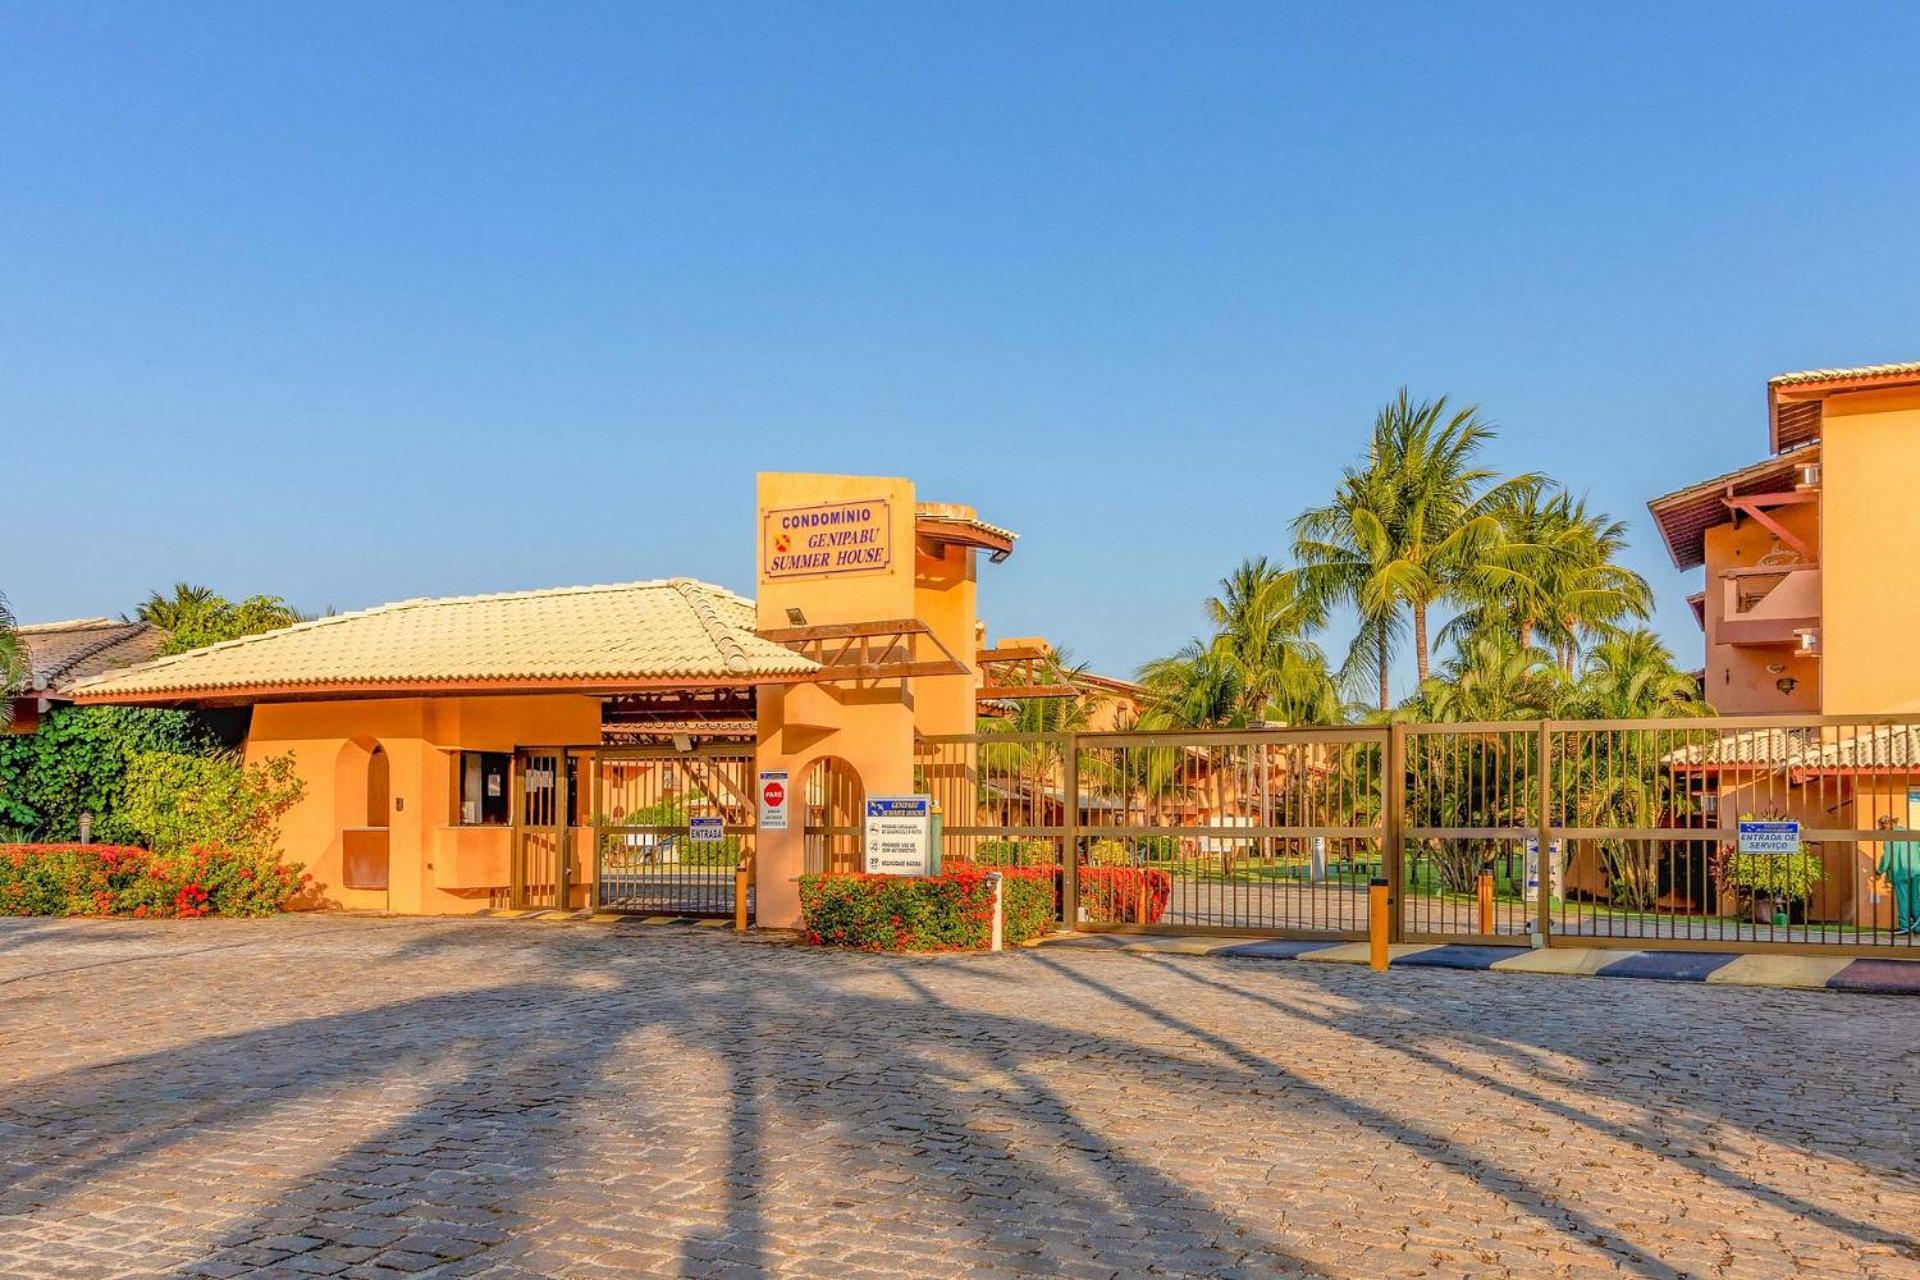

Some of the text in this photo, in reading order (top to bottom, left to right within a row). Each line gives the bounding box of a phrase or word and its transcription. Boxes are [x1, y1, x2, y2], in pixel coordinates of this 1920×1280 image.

[782, 508, 871, 529] CONDOMÍNIO
[808, 528, 880, 548] GENIPABU
[771, 547, 884, 571] SUMMER HOUSE
[691, 829, 721, 838] ENTRADA
[1749, 842, 1788, 850] SERVIÇO
